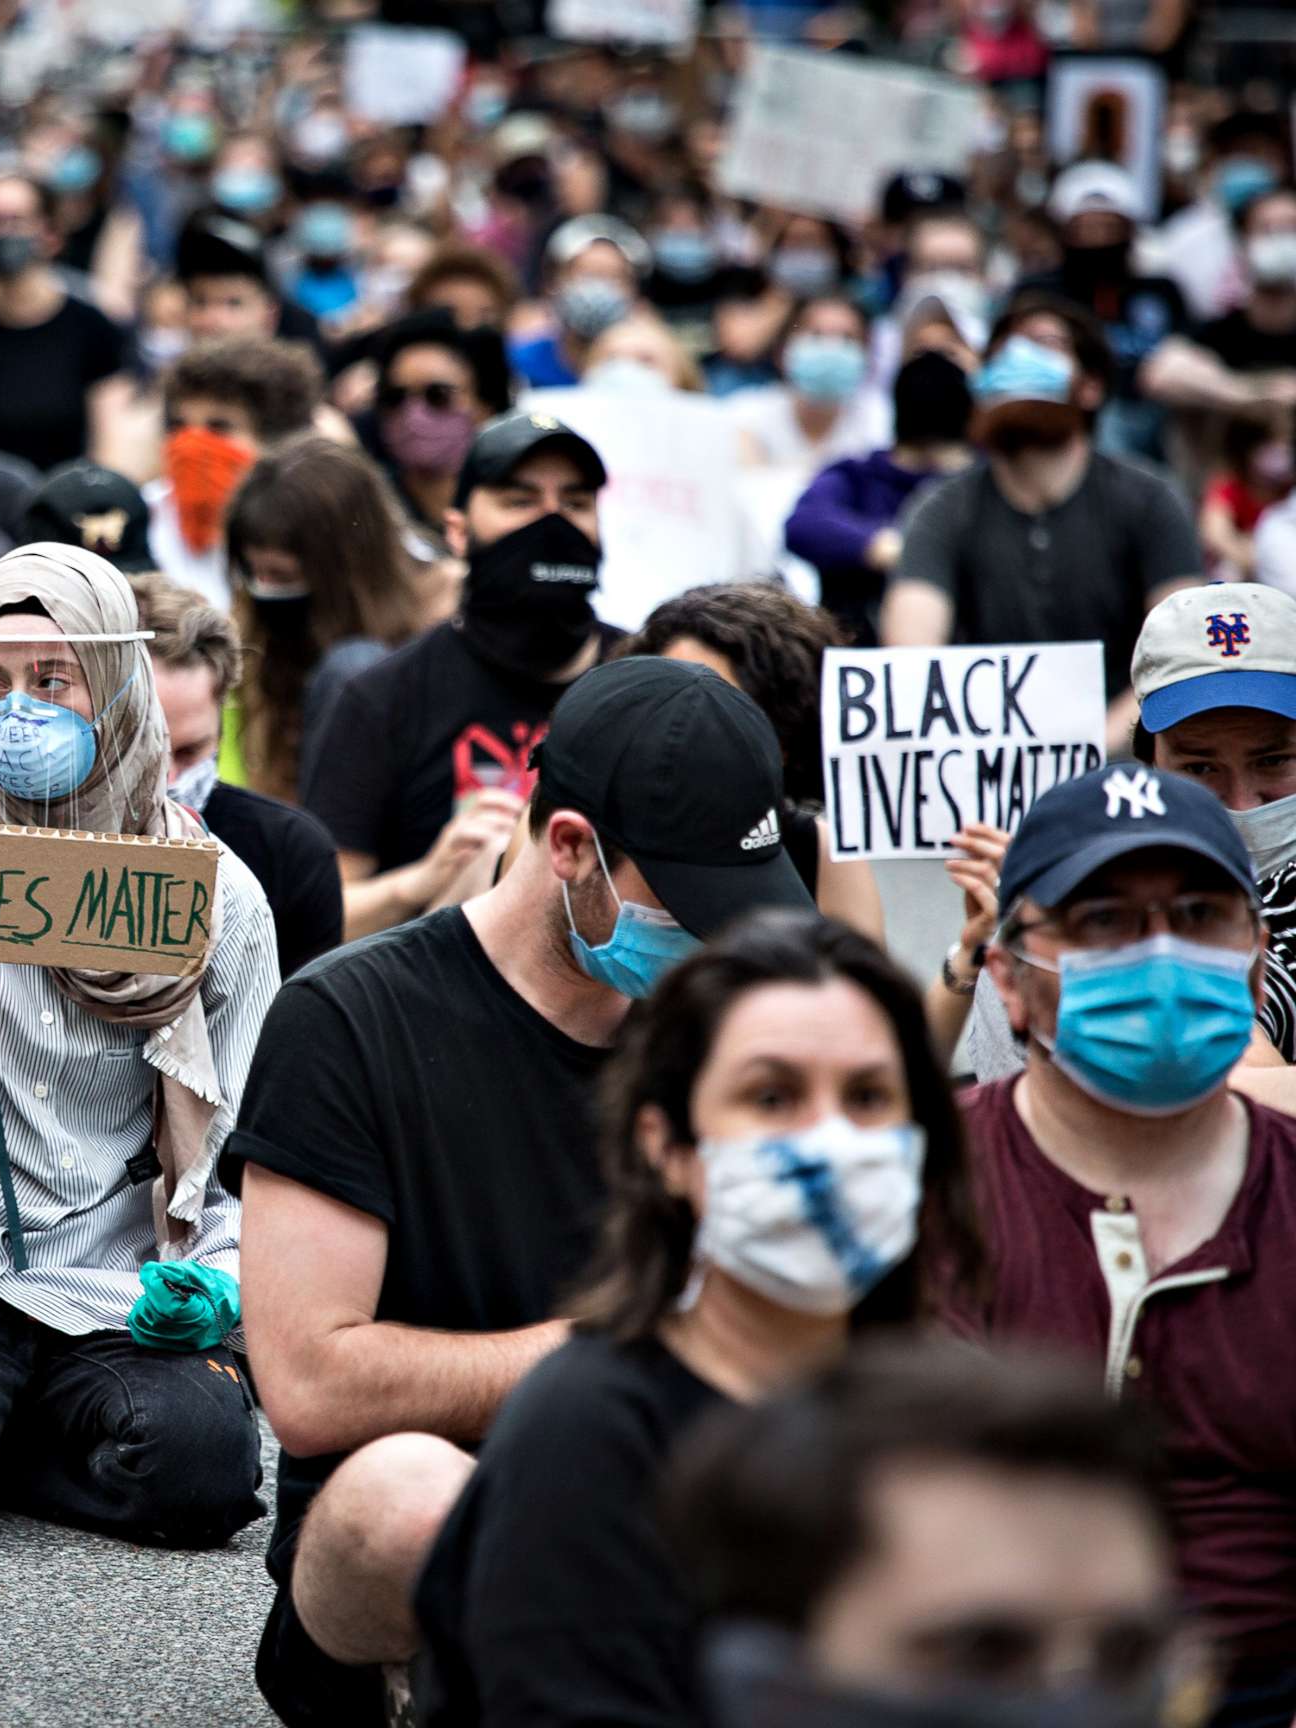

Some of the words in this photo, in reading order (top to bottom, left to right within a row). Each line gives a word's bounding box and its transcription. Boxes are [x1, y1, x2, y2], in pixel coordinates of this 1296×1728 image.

[1205, 613, 1251, 658] NY
[838, 653, 1040, 743] BLACK
[830, 748, 963, 853] LIVES
[1102, 768, 1167, 819] NY
[66, 864, 210, 946] MATTER
